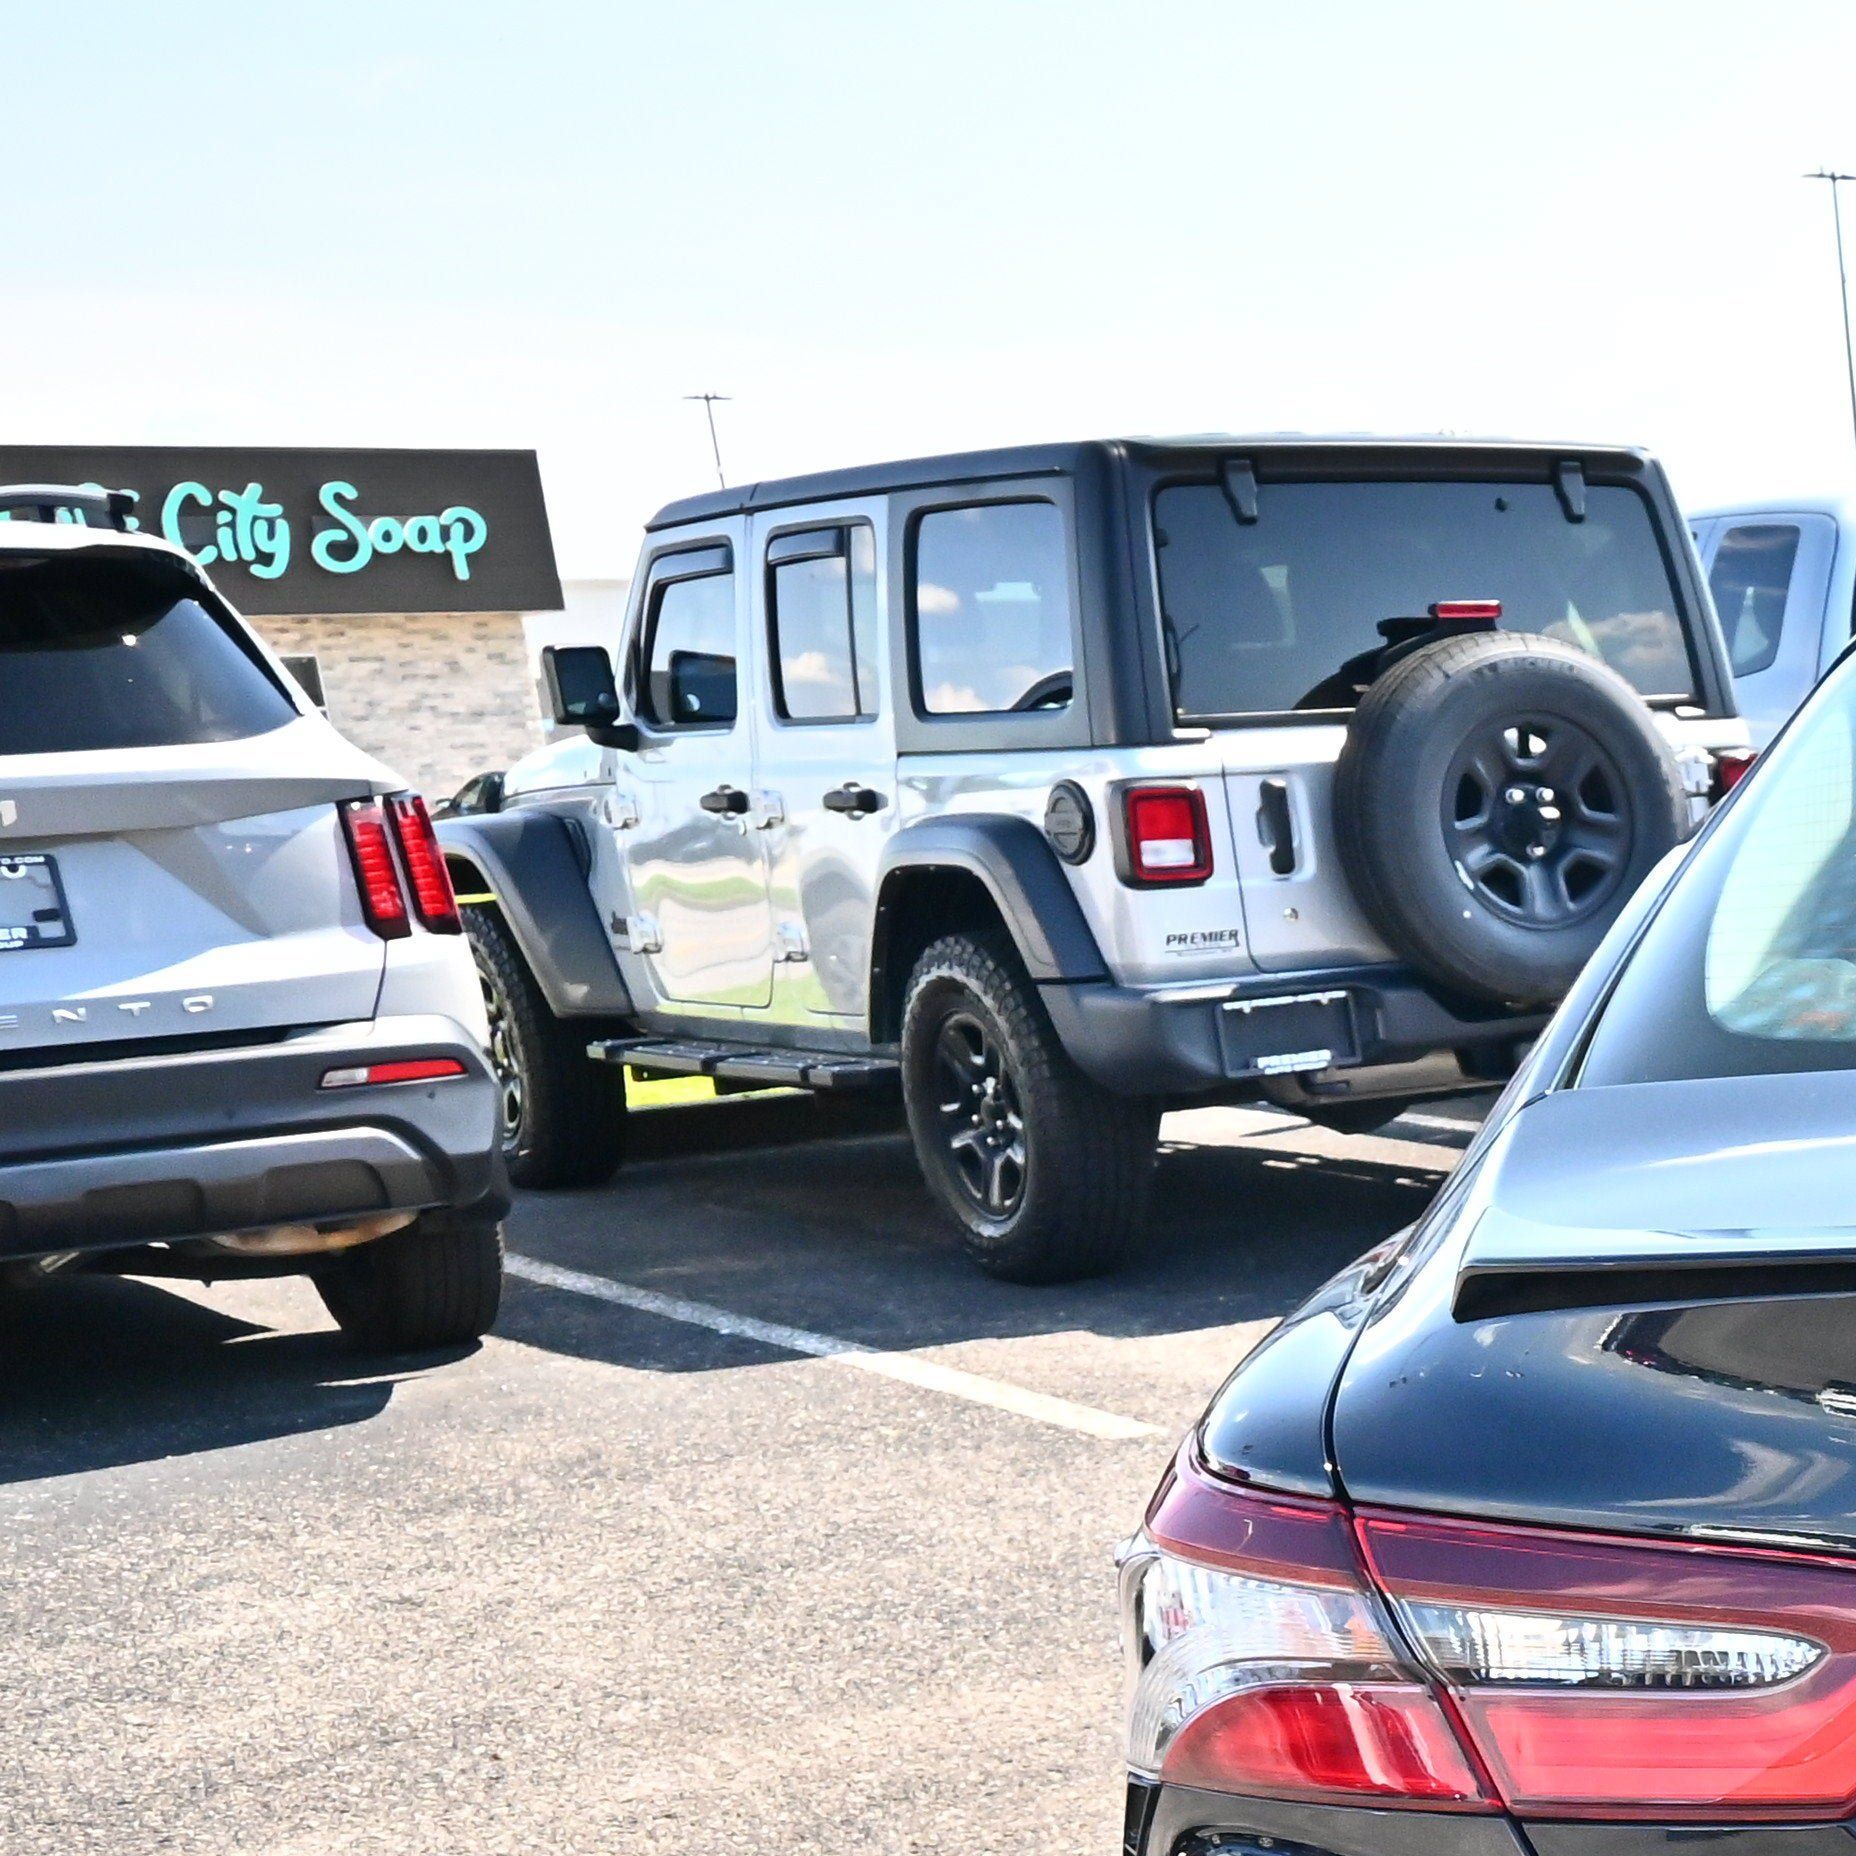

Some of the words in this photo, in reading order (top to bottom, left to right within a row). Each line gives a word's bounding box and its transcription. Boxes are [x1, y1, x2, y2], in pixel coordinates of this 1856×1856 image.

[161, 481, 291, 580] City
[311, 480, 487, 581] Soap
[1165, 929, 1239, 947] PREMIER
